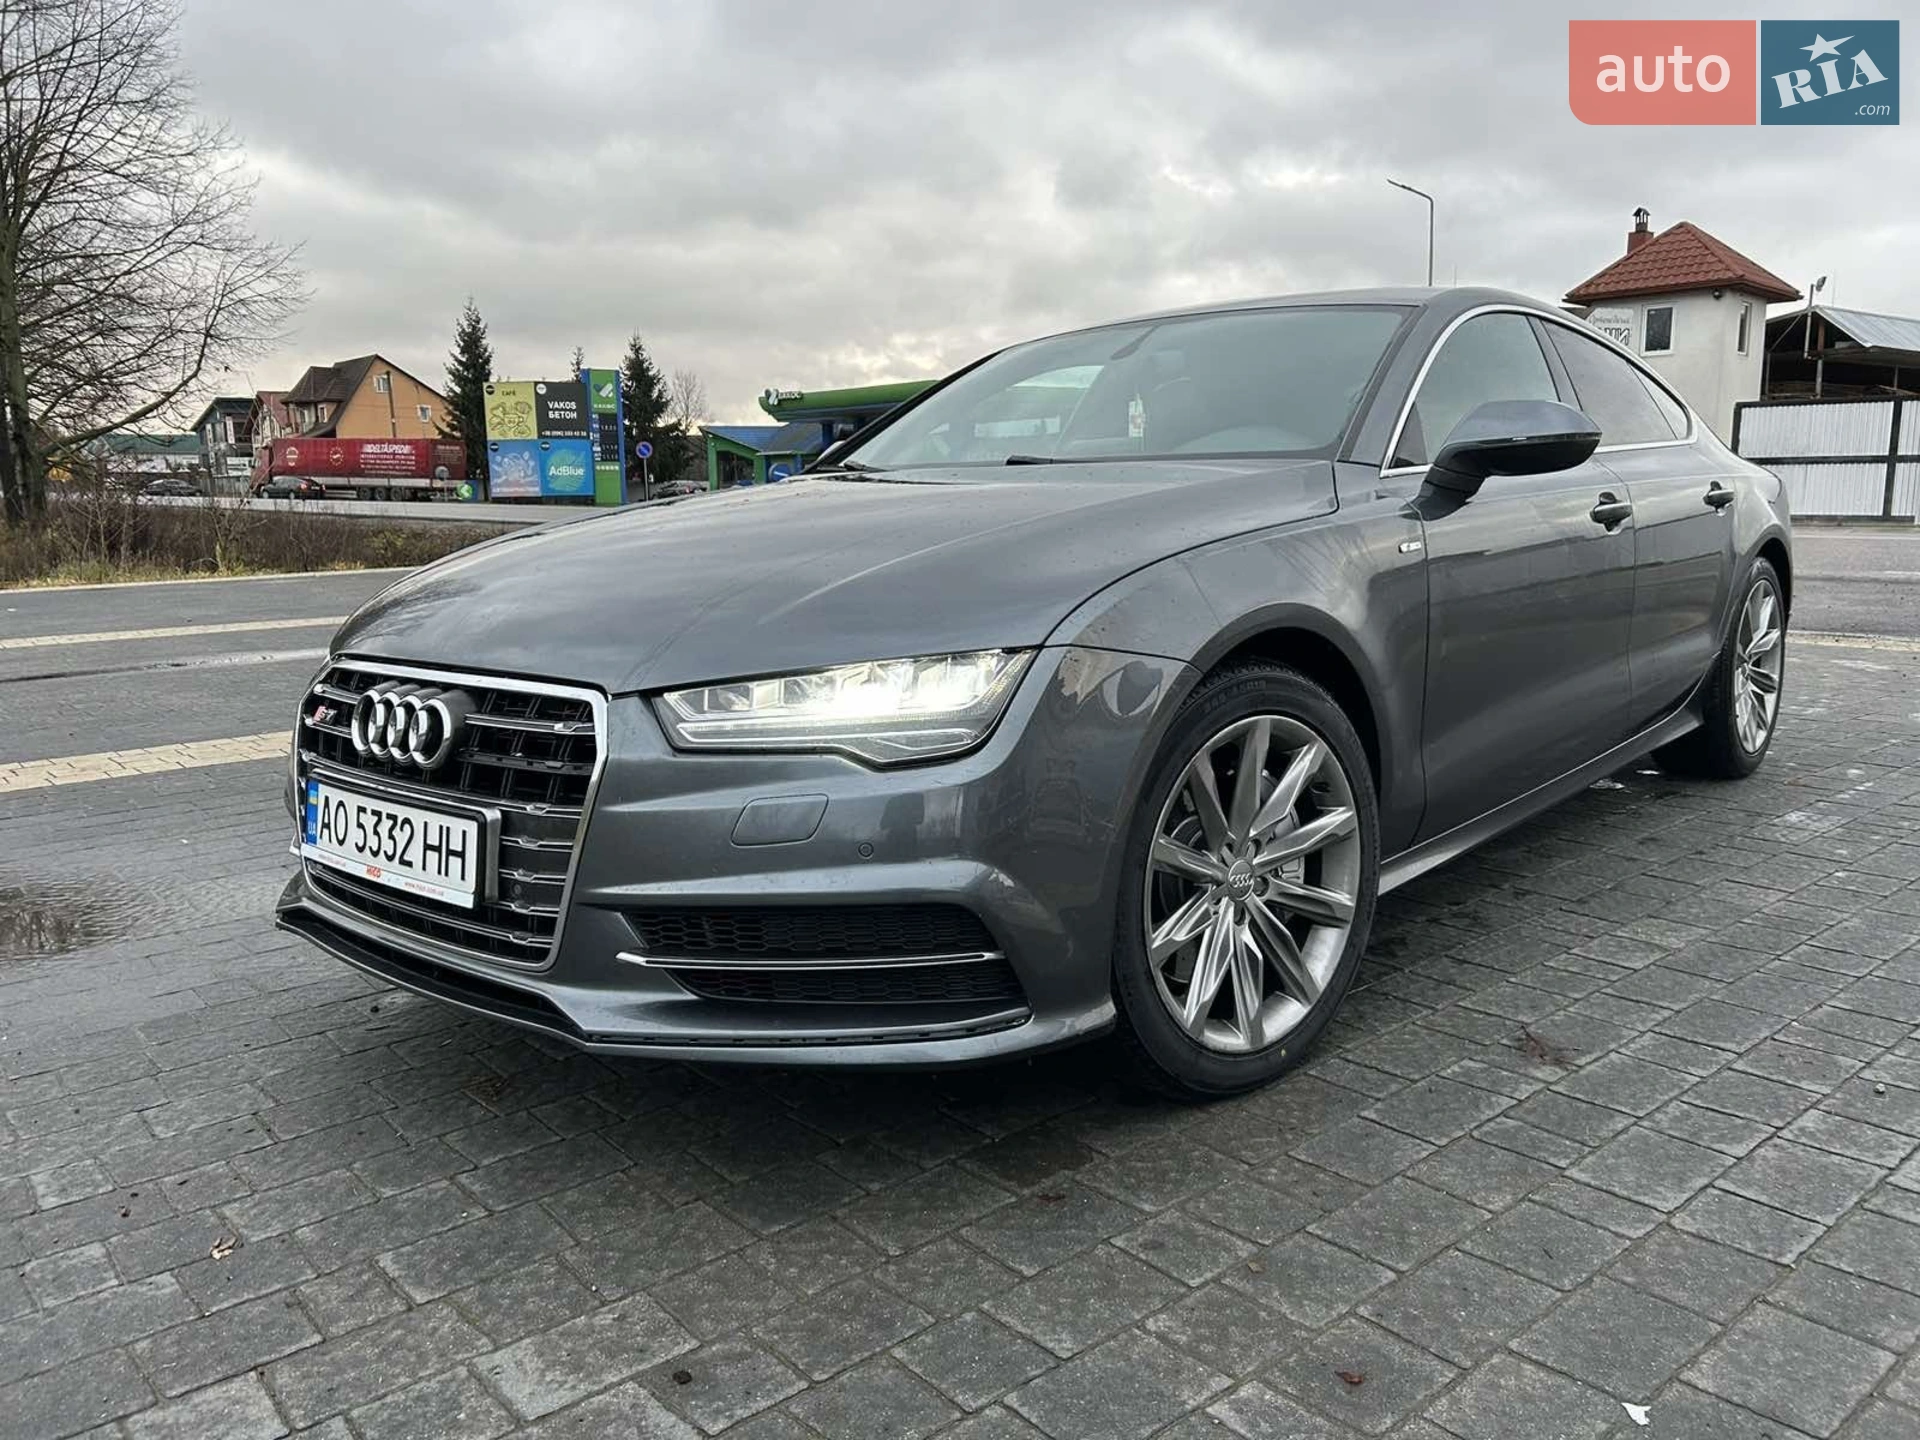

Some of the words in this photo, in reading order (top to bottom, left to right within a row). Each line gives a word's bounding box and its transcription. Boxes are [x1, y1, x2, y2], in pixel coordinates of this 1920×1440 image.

[547, 401, 576, 410] VAKOS
[548, 411, 577, 420] БЕТОН
[549, 466, 584, 476] AdBlue
[307, 821, 317, 835] UA
[319, 795, 349, 846] AO
[354, 805, 415, 869] 5332
[422, 821, 467, 881] HH
